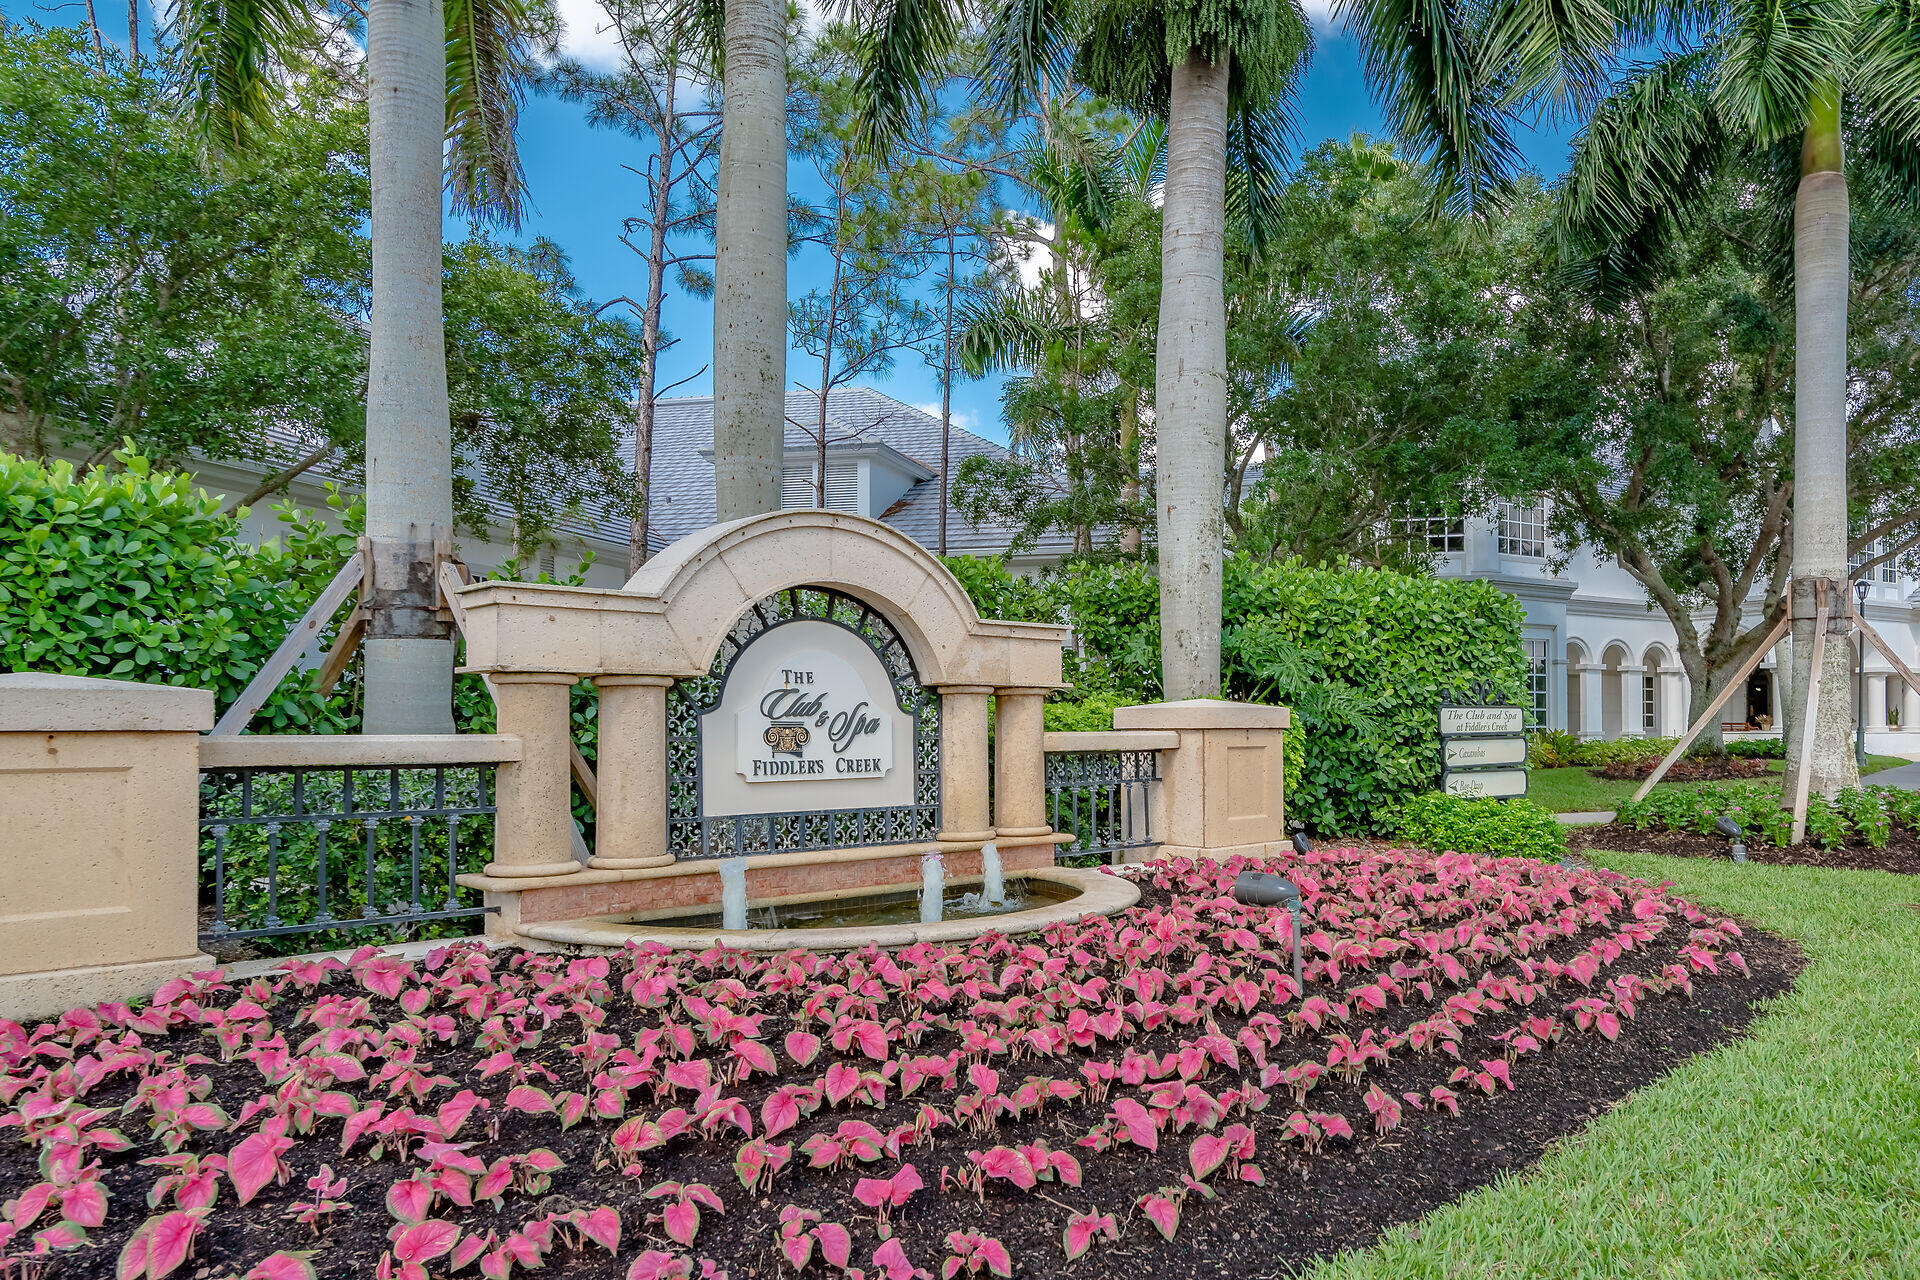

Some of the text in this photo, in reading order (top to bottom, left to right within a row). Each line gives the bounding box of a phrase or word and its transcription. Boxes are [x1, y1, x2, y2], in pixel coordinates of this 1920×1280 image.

[782, 669, 814, 684] THE
[760, 688, 881, 753] Club & Spa
[1448, 710, 1517, 722] The Club and Spa
[1465, 722, 1490, 731] Fiddler's
[1491, 722, 1508, 731] Creek
[753, 757, 881, 776] FIDDLER'S CREEK
